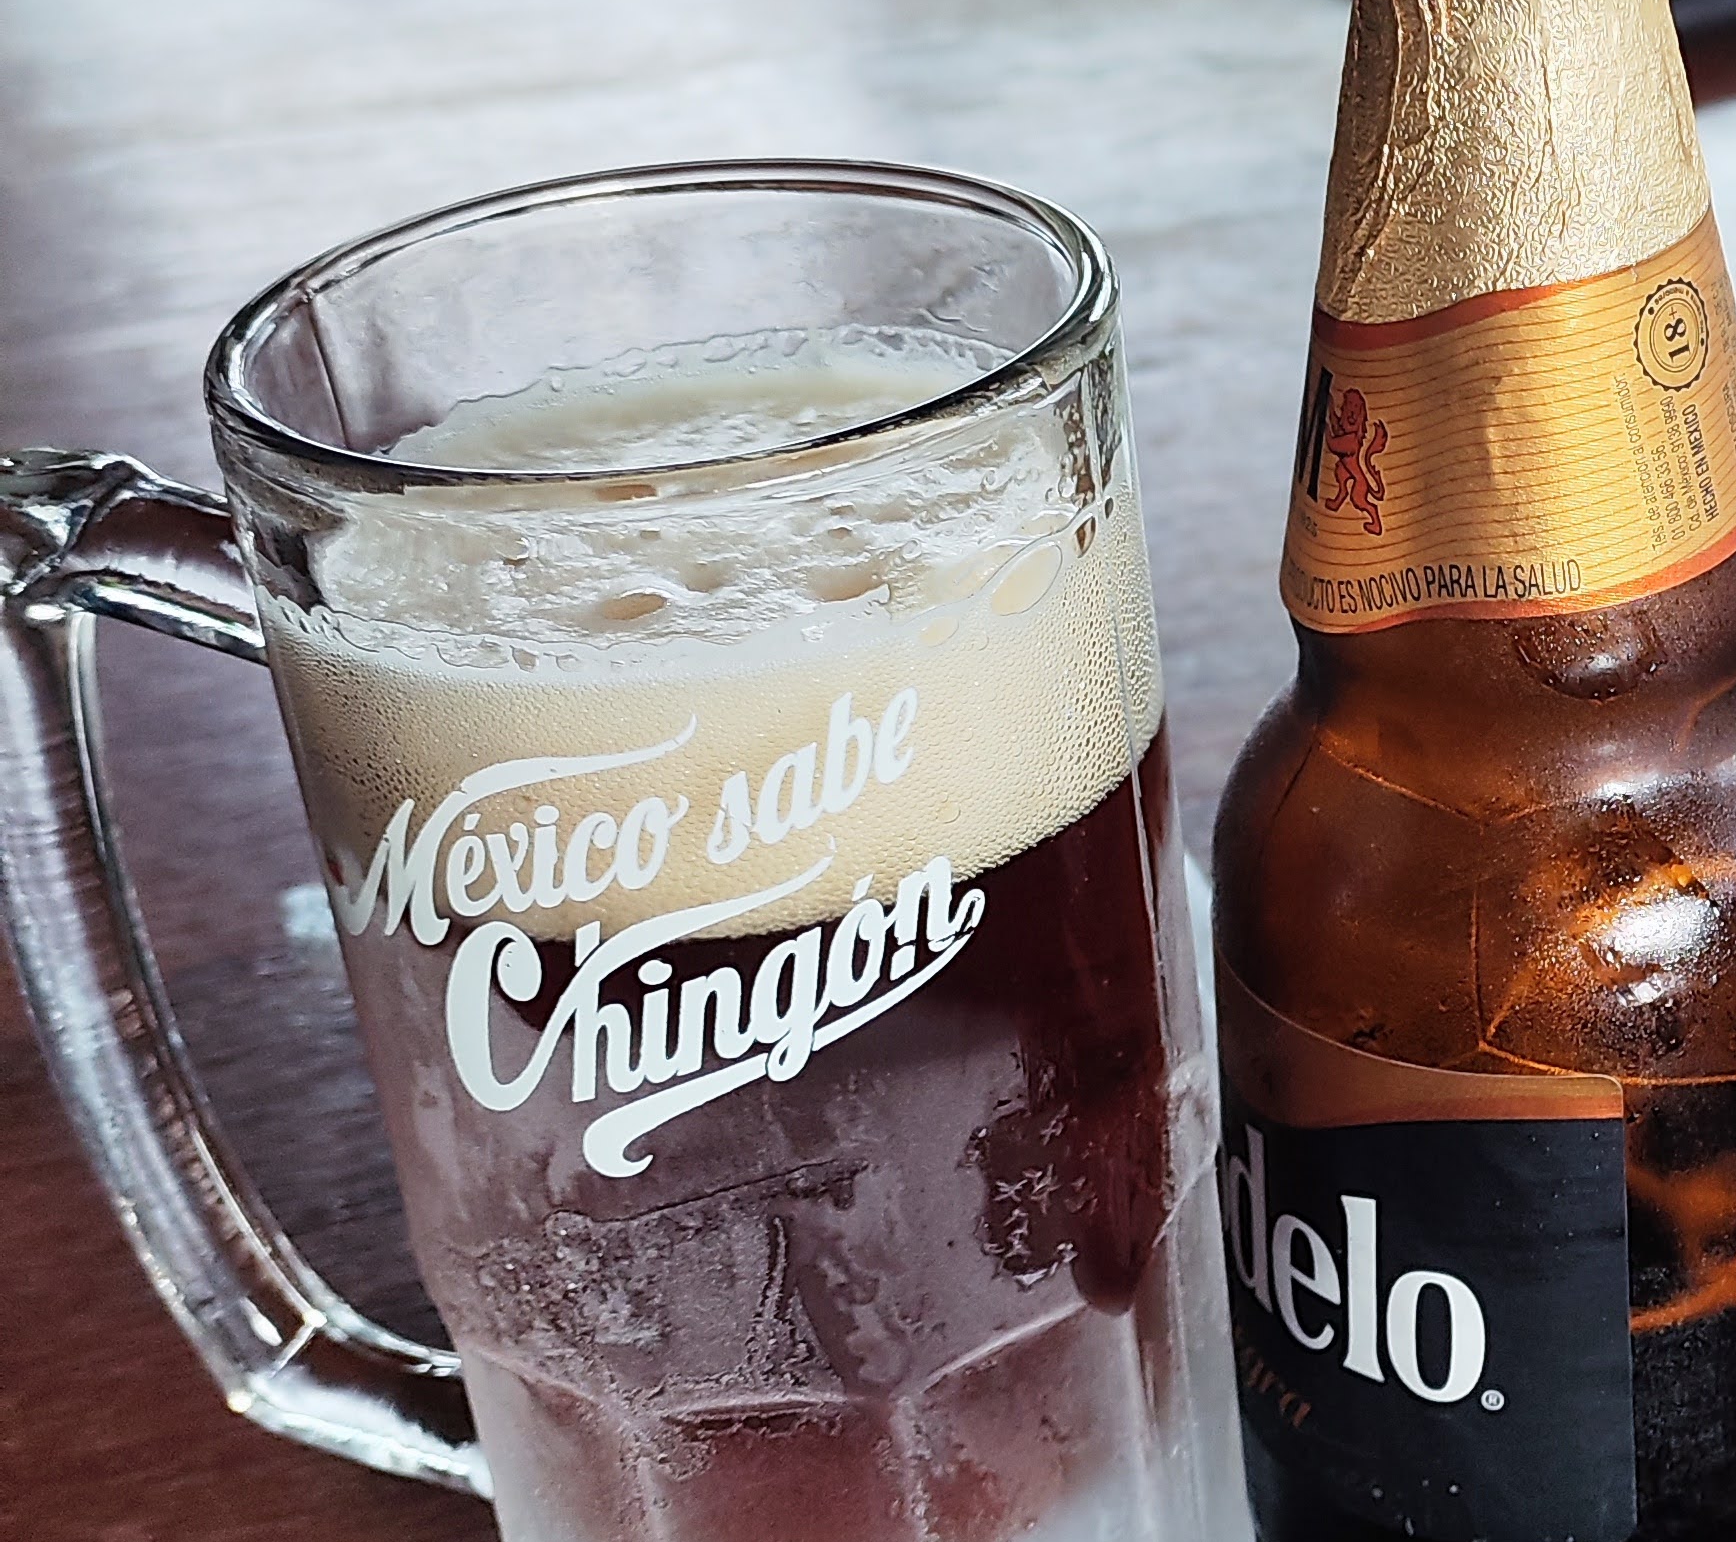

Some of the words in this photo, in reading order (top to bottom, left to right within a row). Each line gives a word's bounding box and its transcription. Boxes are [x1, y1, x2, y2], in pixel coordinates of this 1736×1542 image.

[1681, 403, 1706, 457] MEXICO
[1628, 442, 1645, 455] al
[1655, 461, 1671, 478] 33
[1694, 455, 1710, 477] EN
[1633, 456, 1657, 505] atención
[1659, 477, 1676, 499] 466
[1686, 494, 1698, 510] de
[1698, 476, 1719, 523] HECHO
[1647, 505, 1661, 521] de
[1665, 500, 1682, 524] 800
[1670, 524, 1686, 540] 01
[1338, 578, 1358, 614] ES
[1357, 566, 1422, 613] NOCIVO
[1423, 563, 1476, 599] PARA
[1482, 565, 1509, 599] LA
[1513, 558, 1583, 599] SALUD
[336, 713, 698, 946] México
[706, 686, 920, 865] sabe
[445, 834, 987, 1179] Chingón
